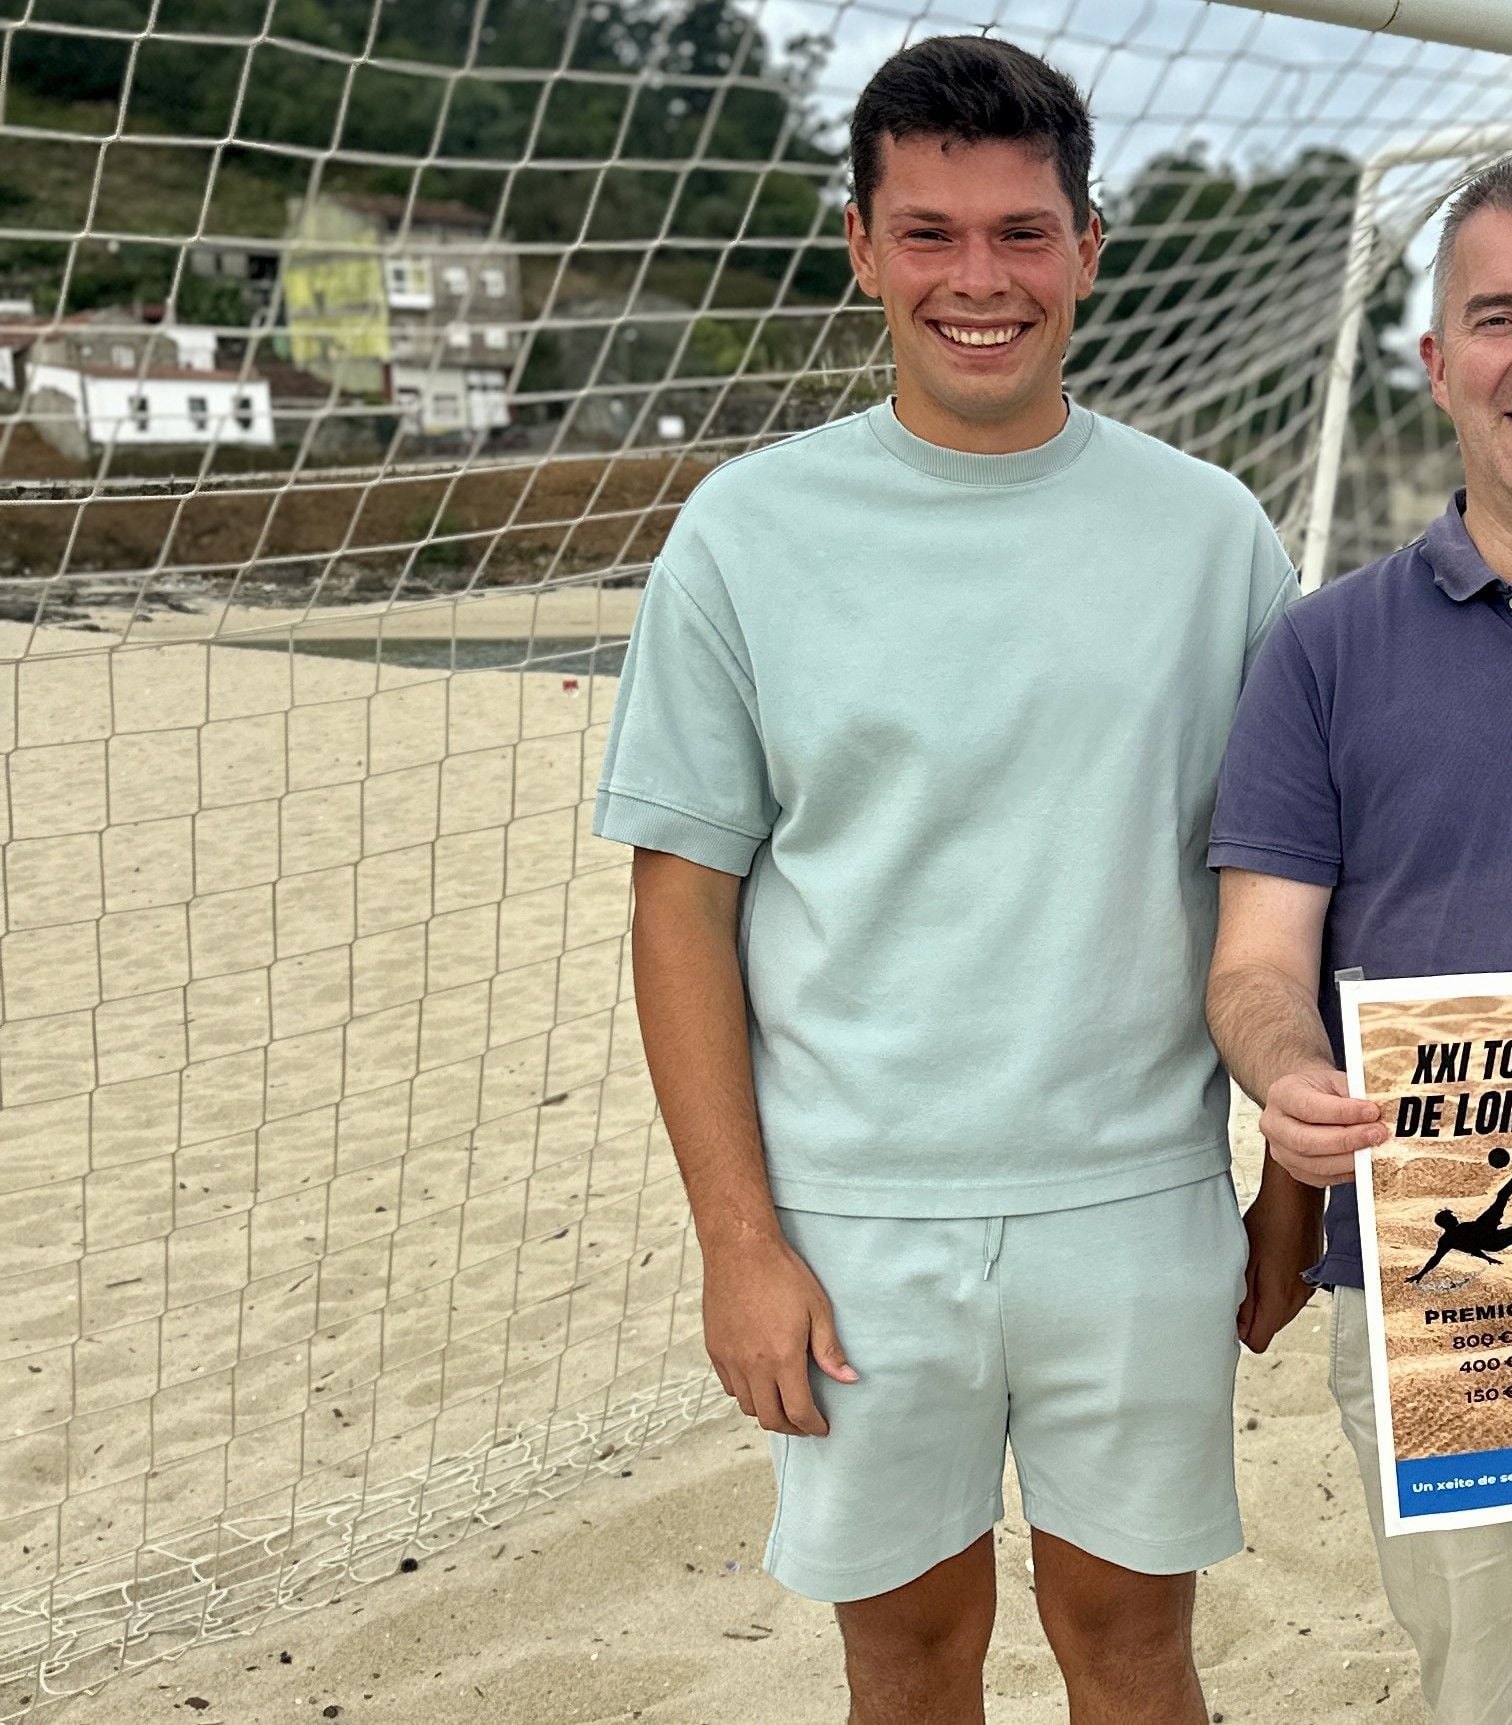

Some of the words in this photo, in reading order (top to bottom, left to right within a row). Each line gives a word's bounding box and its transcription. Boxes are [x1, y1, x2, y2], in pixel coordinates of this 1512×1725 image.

[1411, 1041, 1472, 1085] XXI
[1395, 1094, 1446, 1138] DE
[1453, 1333, 1495, 1349] 800
[1459, 1357, 1501, 1373] 400
[1464, 1388, 1499, 1403] 150
[1412, 1482, 1433, 1493] Un
[1436, 1478, 1474, 1491] xeito
[1477, 1475, 1497, 1486] de
